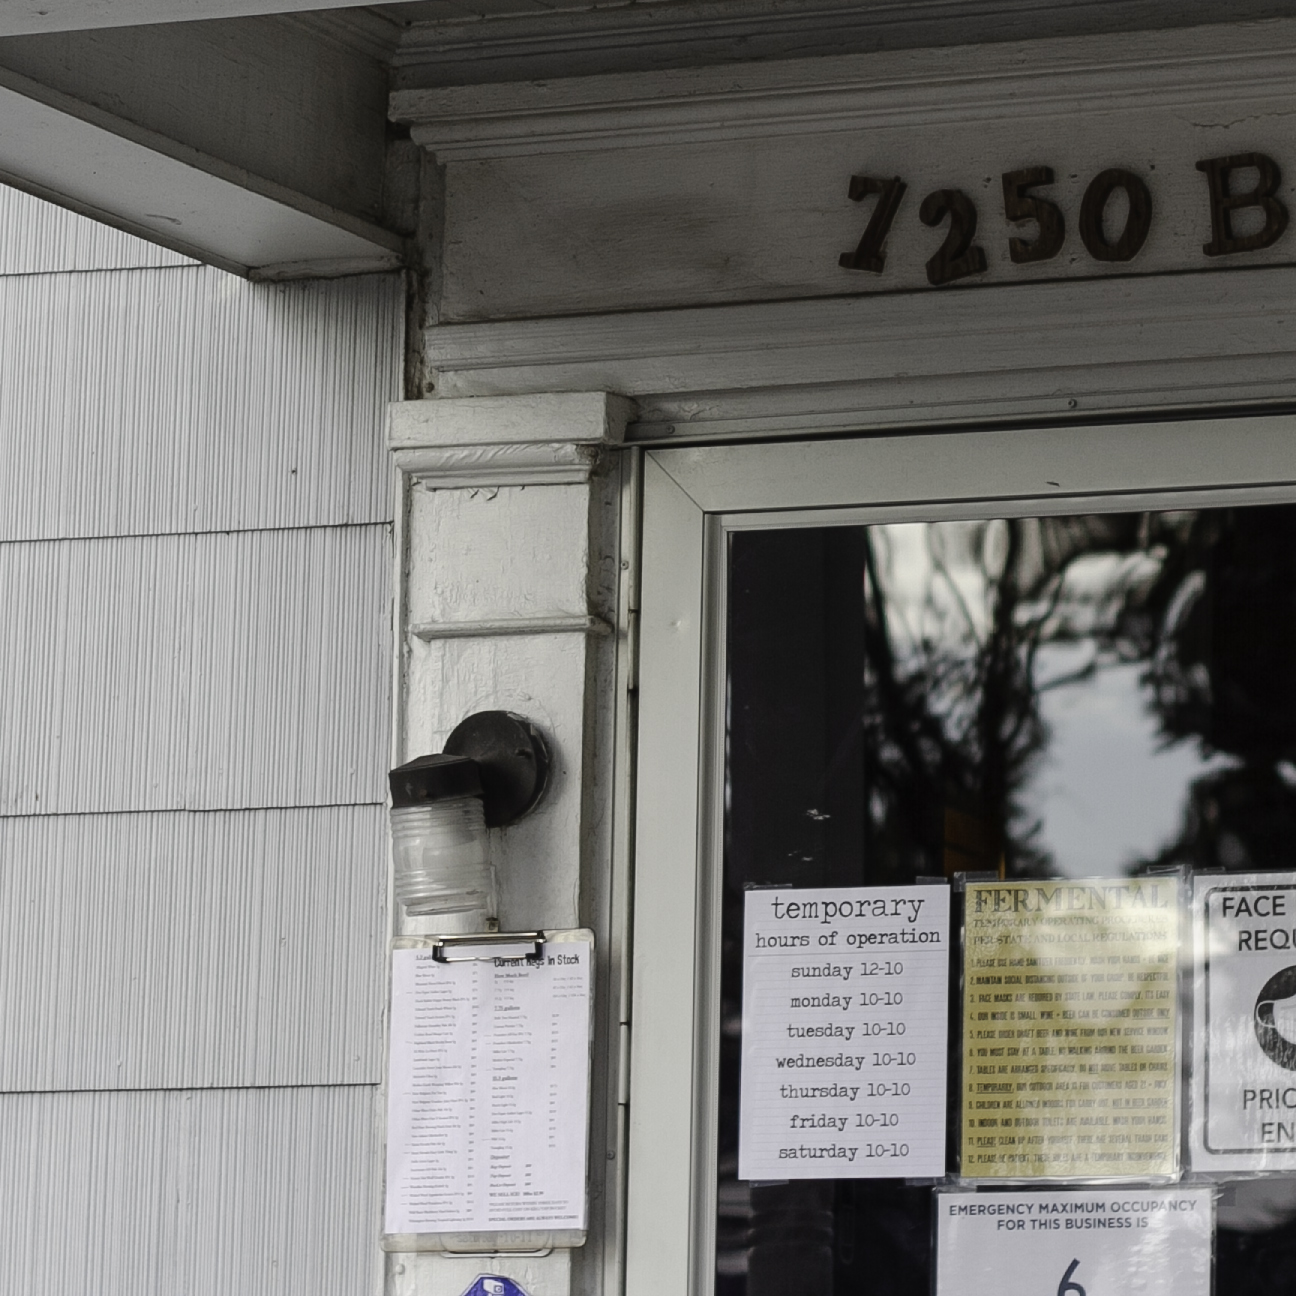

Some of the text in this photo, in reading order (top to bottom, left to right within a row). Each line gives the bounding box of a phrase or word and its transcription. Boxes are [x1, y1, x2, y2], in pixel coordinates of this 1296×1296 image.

[839, 152, 1290, 285] 7250 B
[973, 885, 1169, 913] FERMENTAL
[1222, 896, 1285, 918] FACE
[771, 897, 924, 924] temporary
[755, 928, 941, 948] hours of operation
[1057, 933, 1090, 943] LOCAL
[1092, 931, 1168, 942] REGULATIONS
[494, 957, 524, 968] Current
[548, 956, 555, 965] In
[558, 954, 580, 965] Stock
[791, 962, 903, 980] sunday 12-10
[790, 992, 903, 1011] monday 10-10
[787, 1022, 906, 1041] tuesday 10-10
[776, 1053, 916, 1071] wednesday 10-10
[780, 1083, 911, 1101] thursday 10-10
[790, 1113, 899, 1132] friday 10-10
[778, 1143, 909, 1161] saturday 10-10
[949, 1200, 1197, 1216] EMERGENCY MAXIMUM OCCUPANCY
[997, 1217, 1149, 1230] FOR THIS BUSINESS IS
[1057, 1258, 1087, 1296] 6
